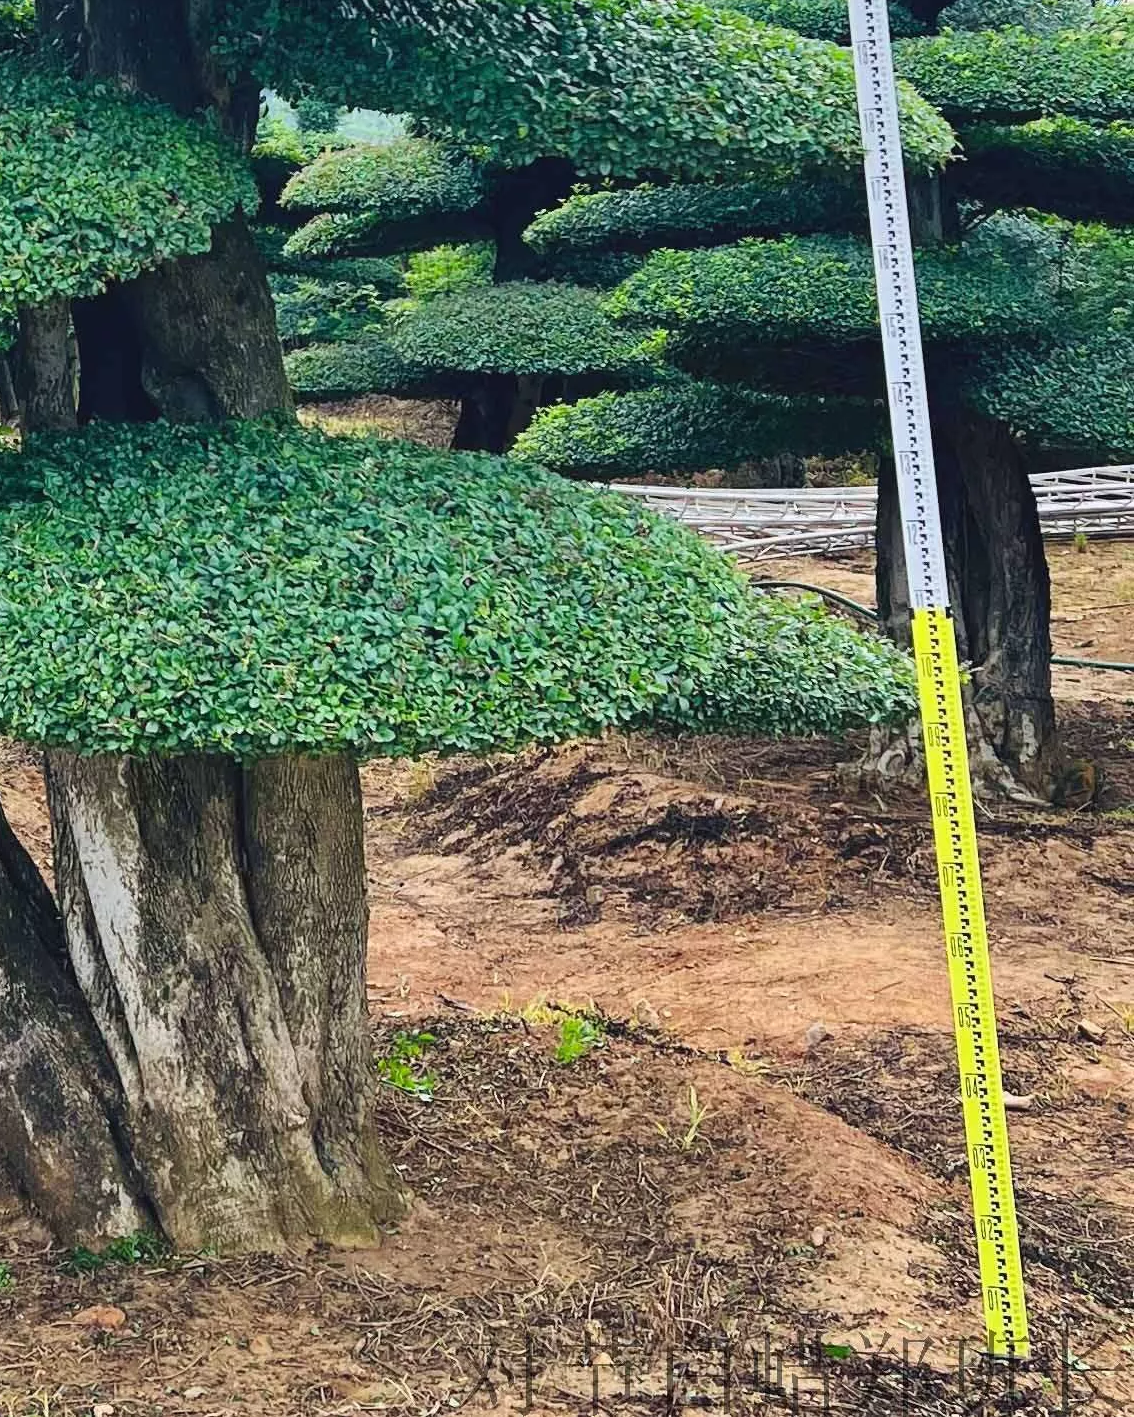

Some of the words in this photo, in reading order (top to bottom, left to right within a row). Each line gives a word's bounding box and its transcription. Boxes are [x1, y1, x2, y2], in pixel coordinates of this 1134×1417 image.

[907, 524, 918, 545] 12
[921, 656, 932, 678] 10
[928, 726, 940, 747] 09
[936, 796, 949, 817] 08
[943, 866, 954, 887] 07
[950, 936, 964, 957] 06
[958, 1007, 971, 1028] 05
[965, 1077, 979, 1098] 04
[973, 1147, 985, 1169] 03
[980, 1219, 993, 1240] 02
[988, 1289, 999, 1311] 01
